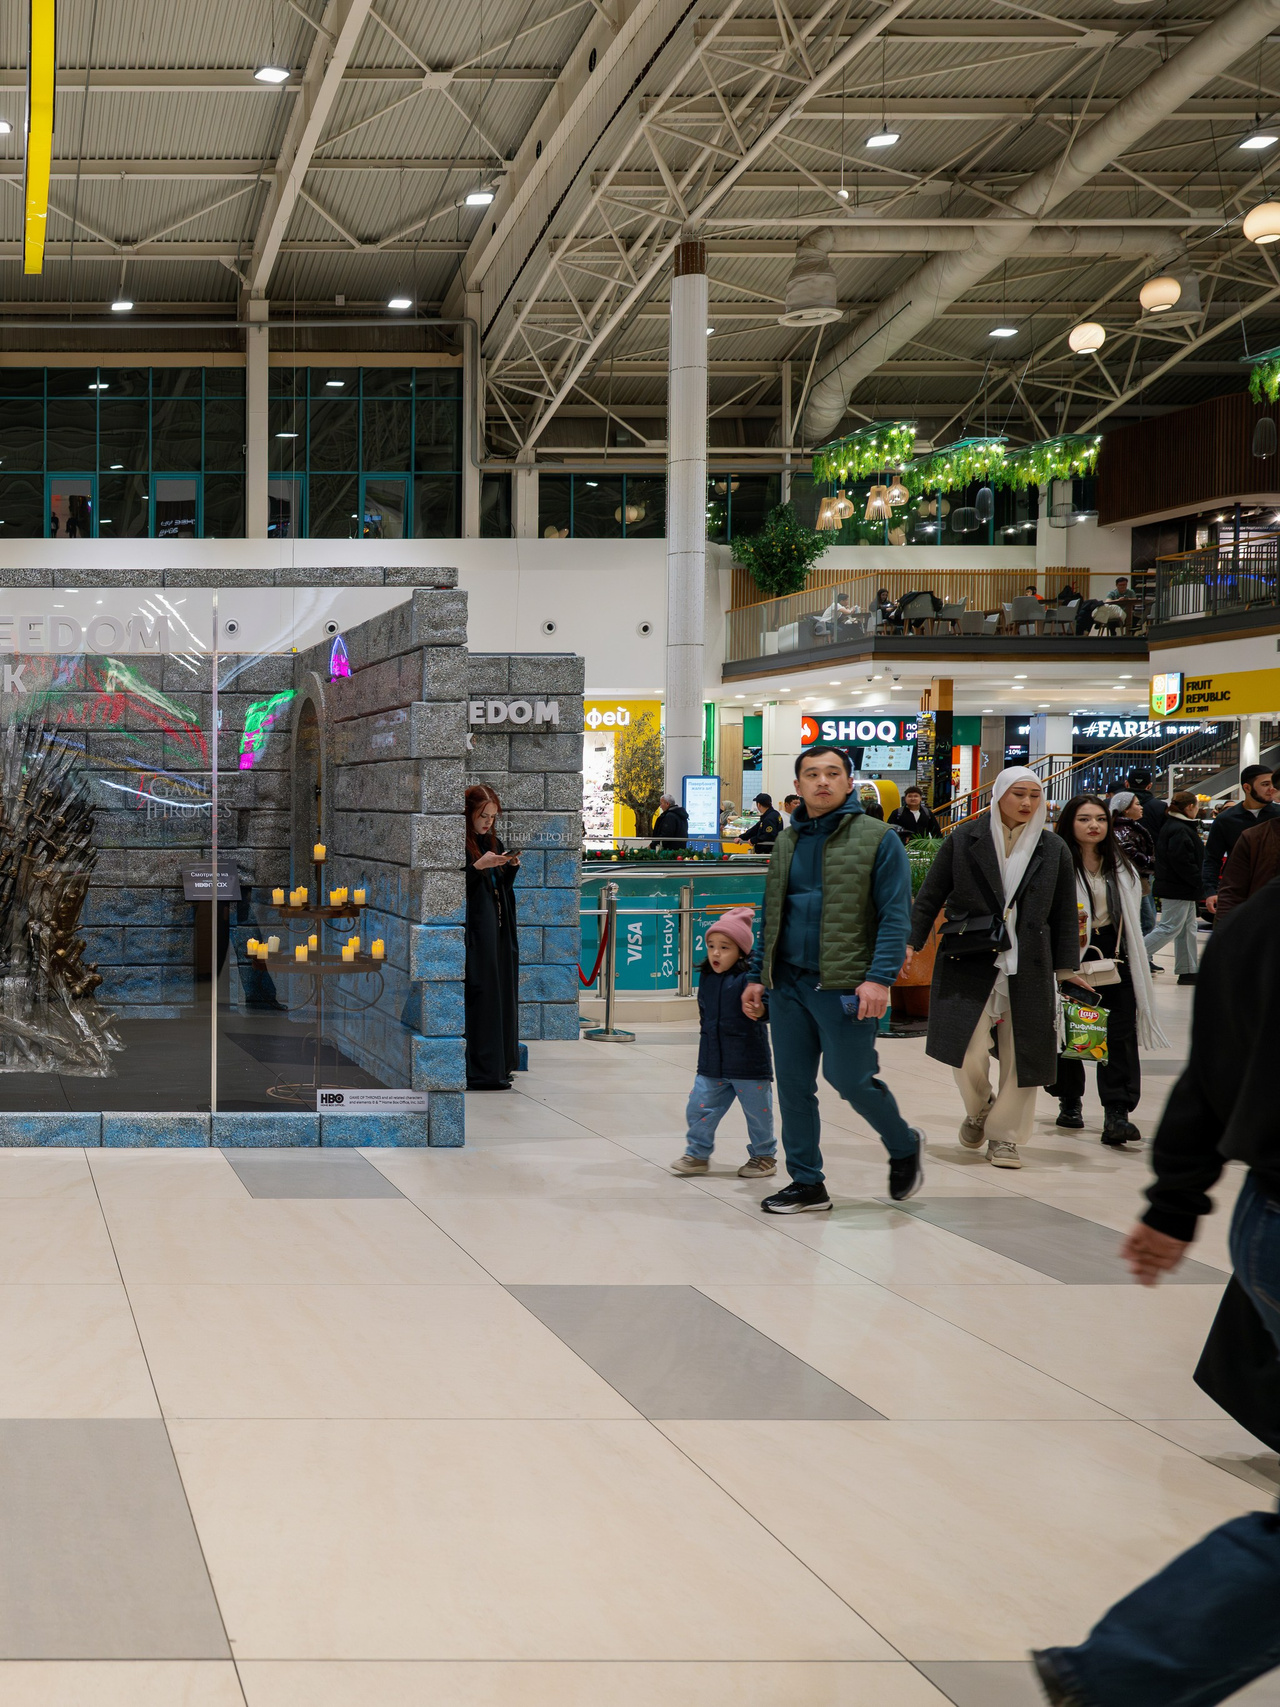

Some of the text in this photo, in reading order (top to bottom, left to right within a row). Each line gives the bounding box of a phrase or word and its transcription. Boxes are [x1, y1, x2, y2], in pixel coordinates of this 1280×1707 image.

[1186, 679, 1213, 691] FRUIT
[1186, 691, 1231, 704] REPUBLIC
[469, 701, 559, 724] EDOM
[586, 706, 630, 729] фей
[822, 721, 897, 742] SHOQ
[150, 777, 211, 799] GAME
[627, 922, 643, 965] VISA
[321, 1093, 344, 1103] HBO
